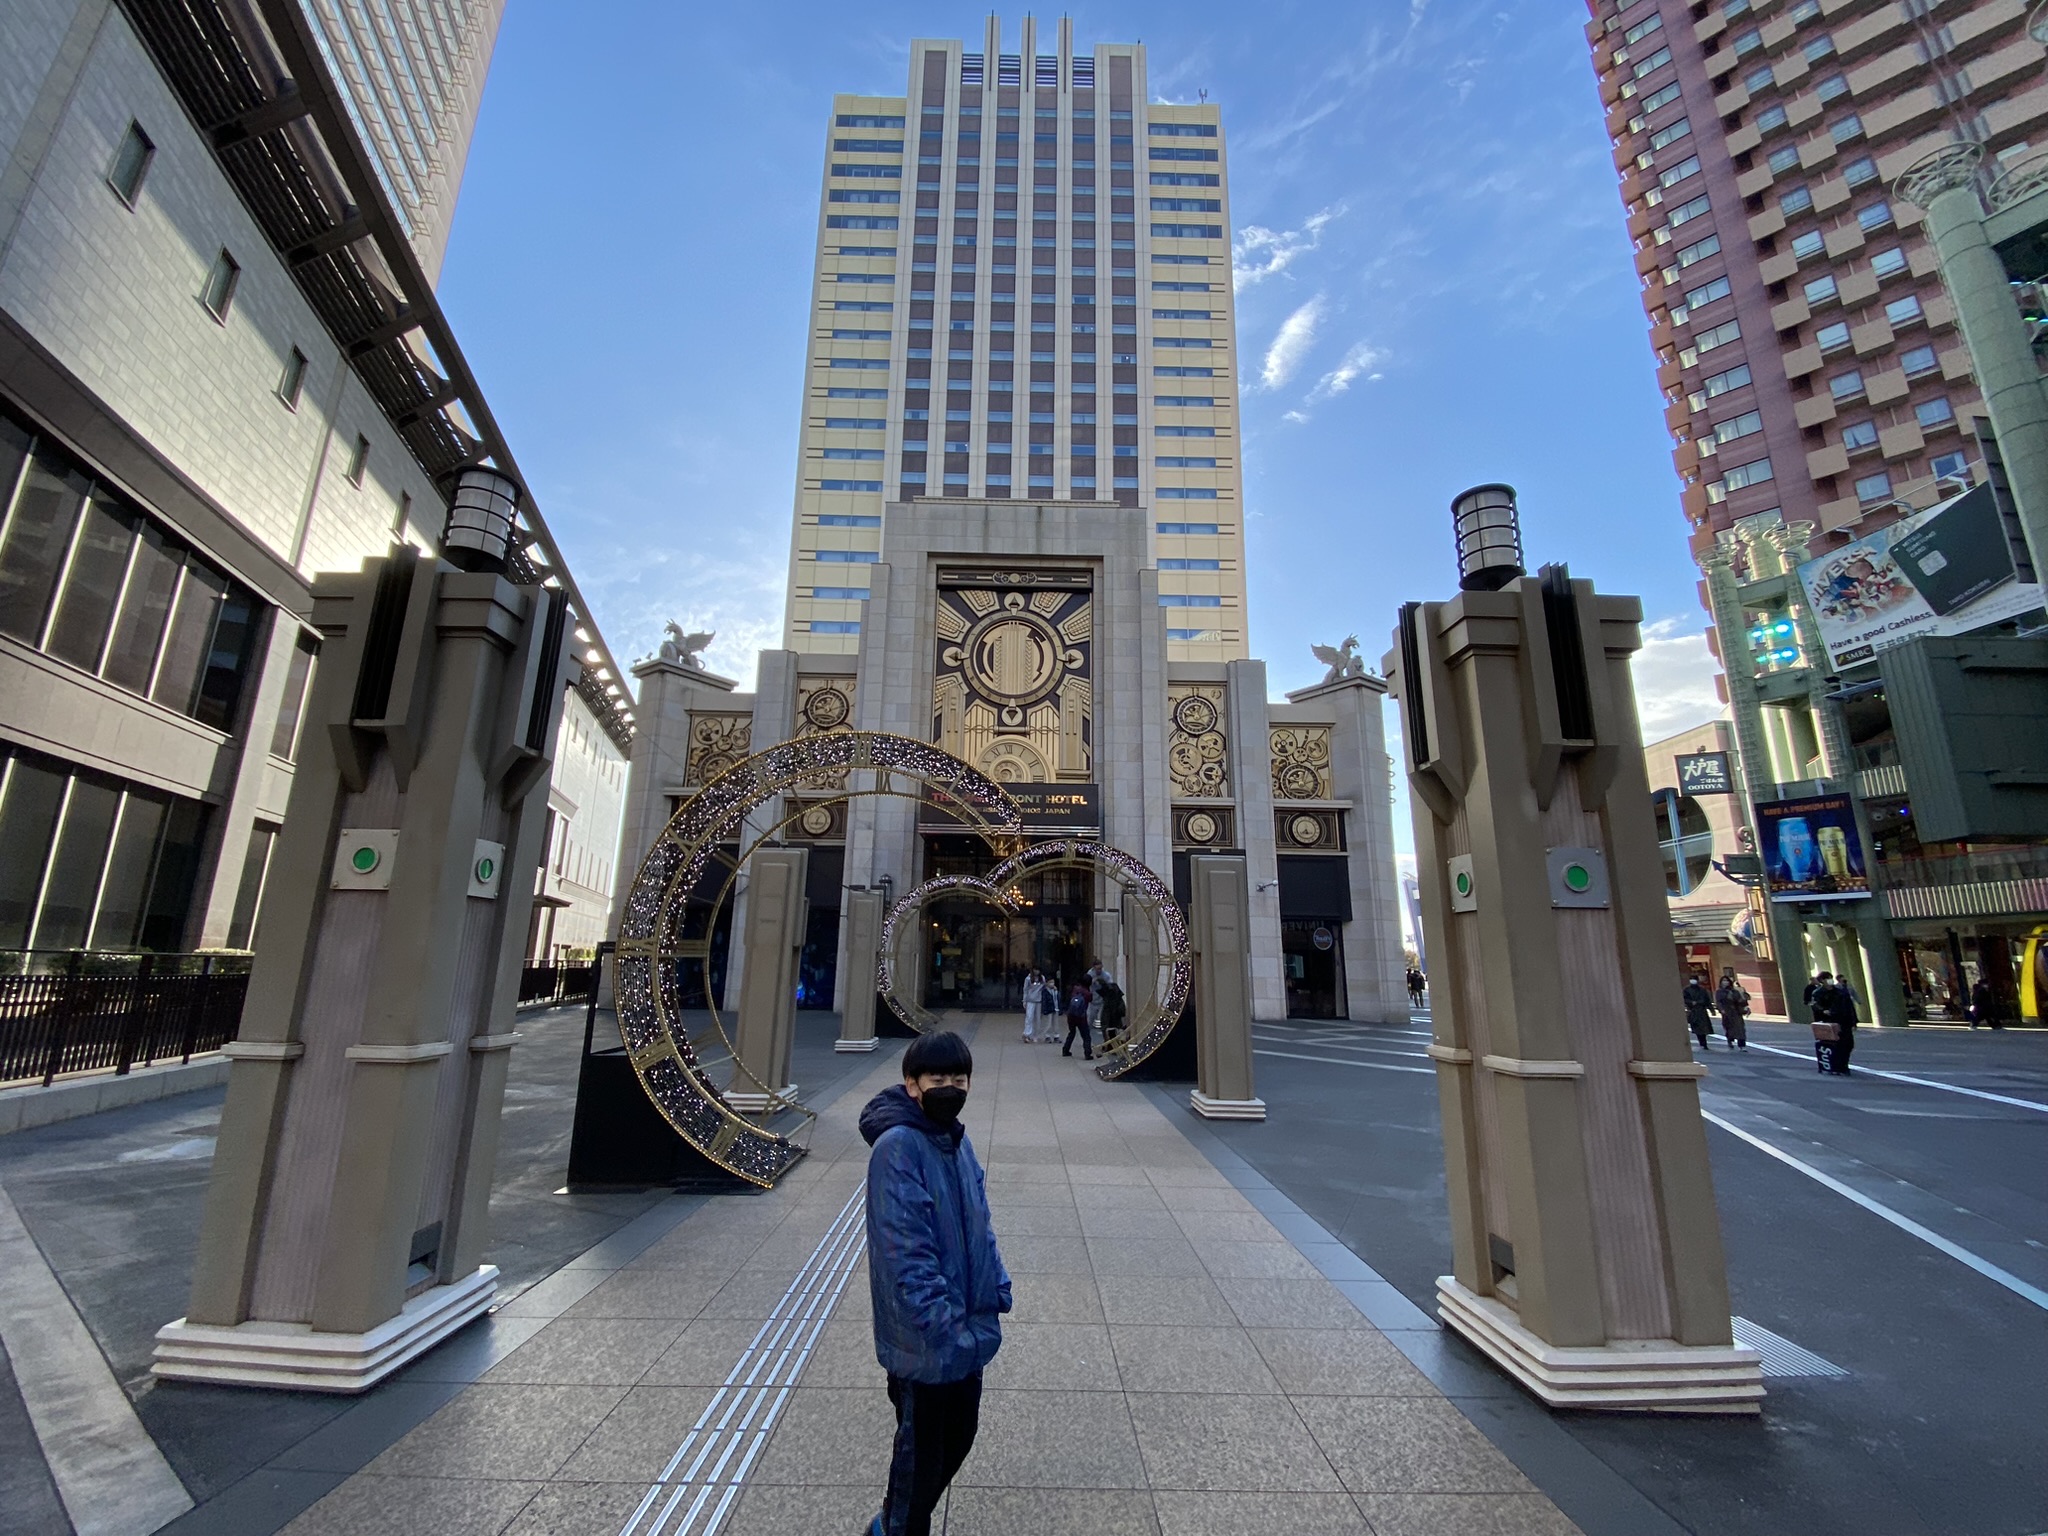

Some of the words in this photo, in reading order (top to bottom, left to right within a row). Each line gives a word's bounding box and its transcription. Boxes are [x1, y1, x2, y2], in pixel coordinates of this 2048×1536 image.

[1830, 639, 1853, 650] Have
[1862, 626, 1886, 641] good
[1846, 647, 1871, 660] SMBC
[1684, 758, 1724, 781] 大戸屋
[1687, 783, 1723, 791] OOTOYA
[1010, 794, 1042, 804] RONT
[1045, 794, 1088, 805] HOTEL
[1790, 803, 1825, 813] PREMIUM
